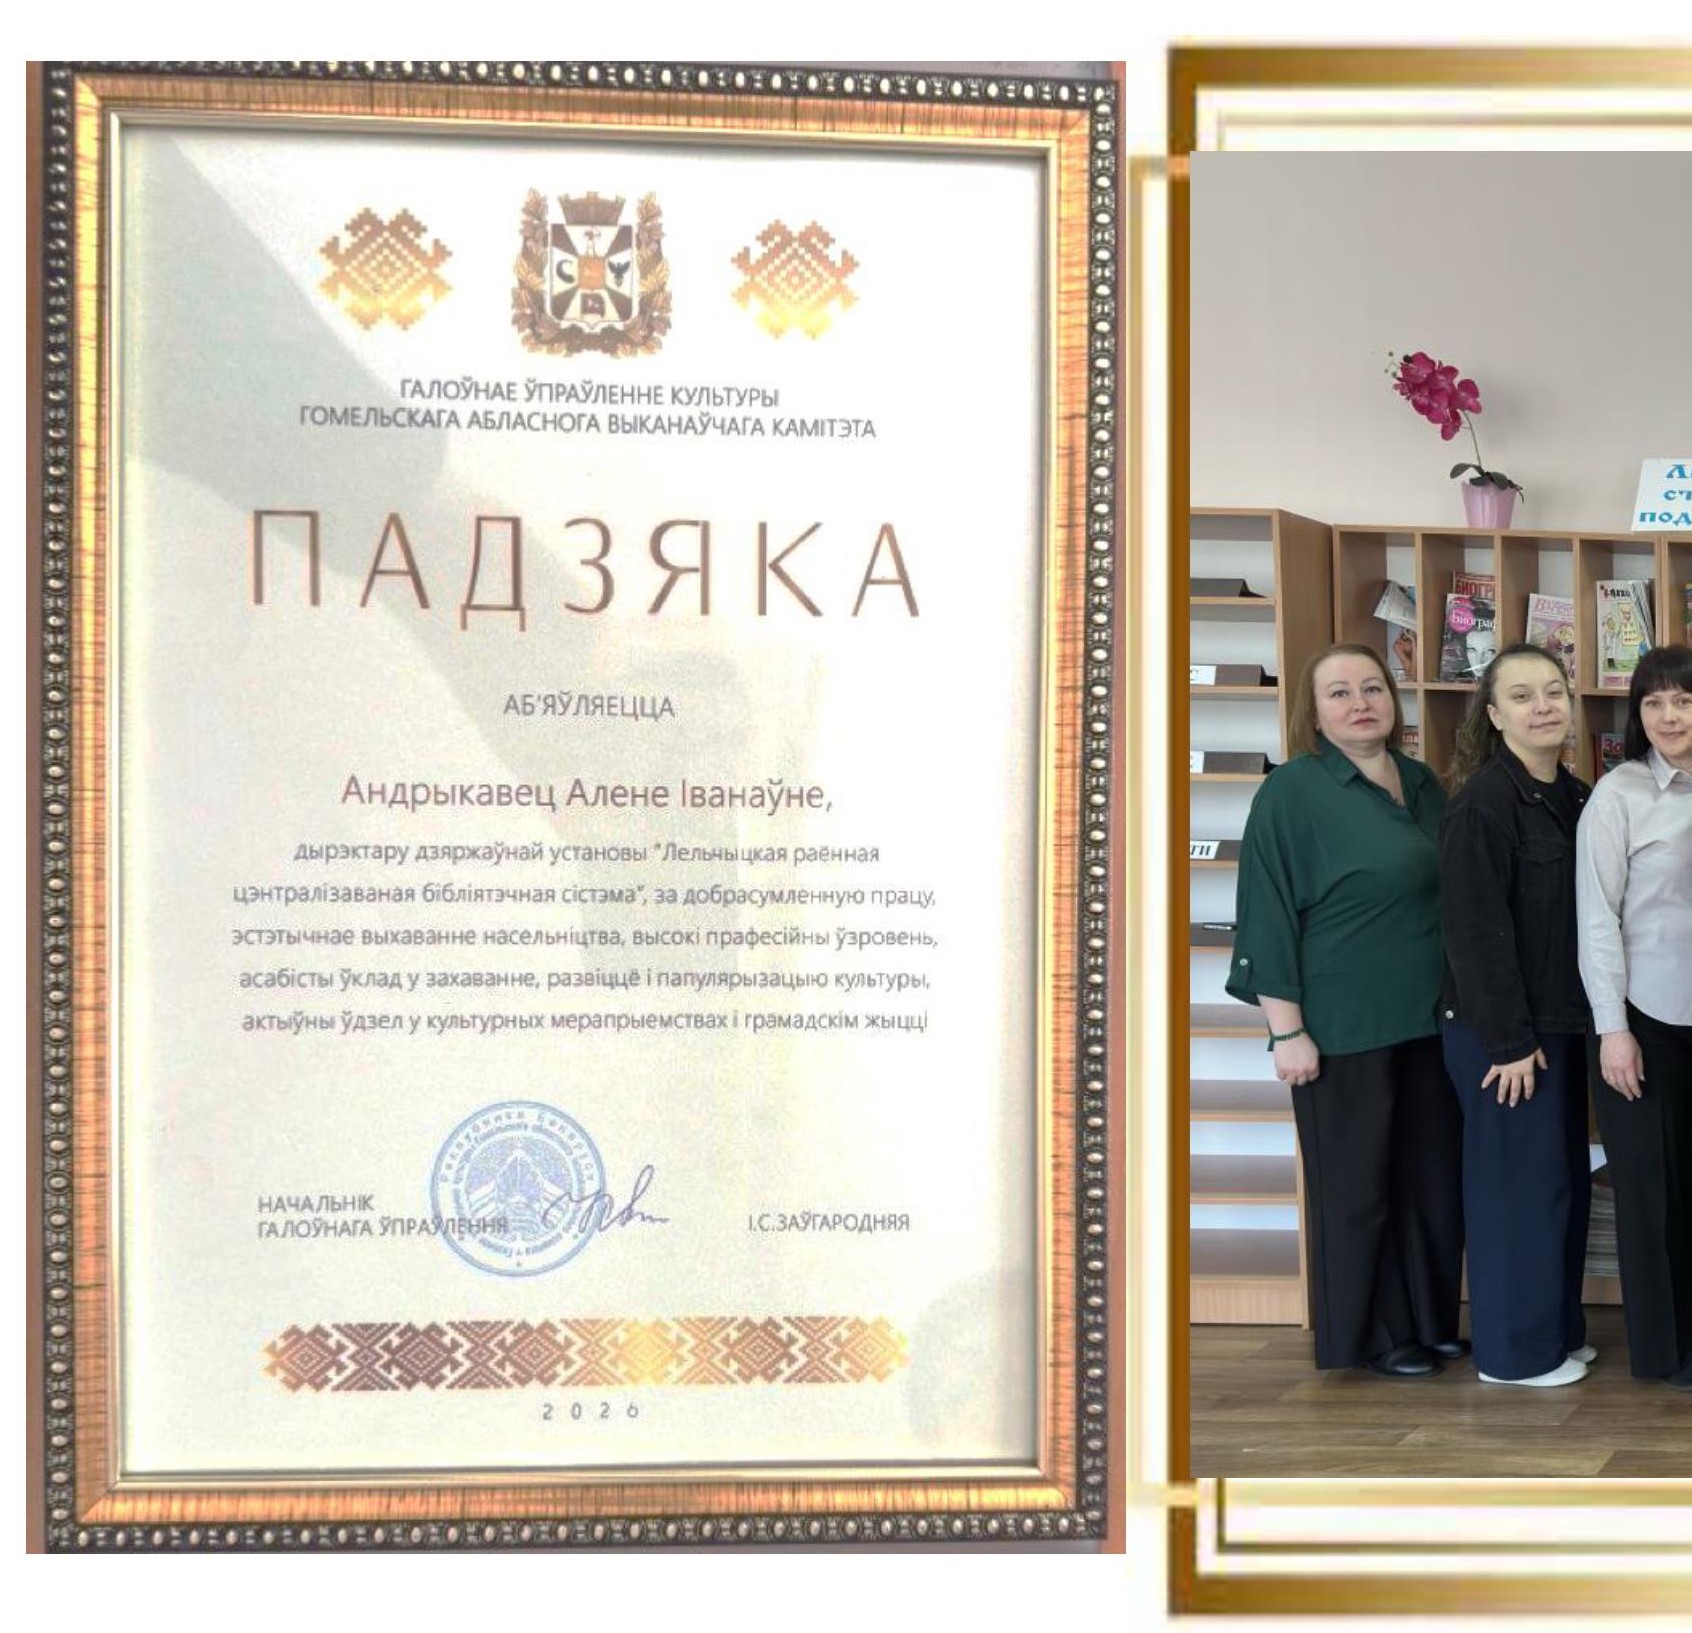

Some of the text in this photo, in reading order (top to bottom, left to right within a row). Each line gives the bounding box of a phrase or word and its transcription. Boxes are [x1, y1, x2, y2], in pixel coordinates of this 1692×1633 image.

[400, 376, 780, 407] ГАЛОЎНАЕ ЎПРАЎЛЕННЕ КУЛЬТУРЫ
[300, 405, 877, 438] ГОМЕЛЬСКАГА АБЛАСНОГА ВЫКАНАЎЧАГА КАМІТЭТА
[248, 507, 922, 633] ПАДЗЯКА
[502, 692, 676, 720] АБ'ЯЎЛЯЕЦЦА
[342, 774, 834, 816] Андрыкавец Алене Іванаўне,
[293, 844, 408, 866] дырэктару
[415, 842, 543, 866] дзяржаўнай
[549, 845, 648, 866] установы
[793, 844, 881, 866] раённая
[233, 884, 415, 905] цэнтралізаваная
[423, 882, 555, 904] бібліятэчная
[655, 888, 678, 905] за
[682, 885, 865, 909] добрасумленную
[871, 889, 936, 909] працу,
[231, 925, 939, 950] эстэтычнае выхаванне насельніцтва, высокі прафесійны ўзровень,
[239, 968, 931, 992] асабісты ўклад у захаванне, развіццё і папулярызацыю культуры,
[242, 1010, 928, 1036] актыўны ўдзел у культурных мерапрыемствах і грамадскім жыцці
[258, 1194, 374, 1216] НАЧАЛЬНІК
[258, 1213, 508, 1239] ГАЛОЎНАГА ЎПРАЎЛЕННЯ
[748, 1210, 911, 1235] І.С.ЗАЎГАРОДНЯЯ
[542, 1402, 640, 1421] 2026
